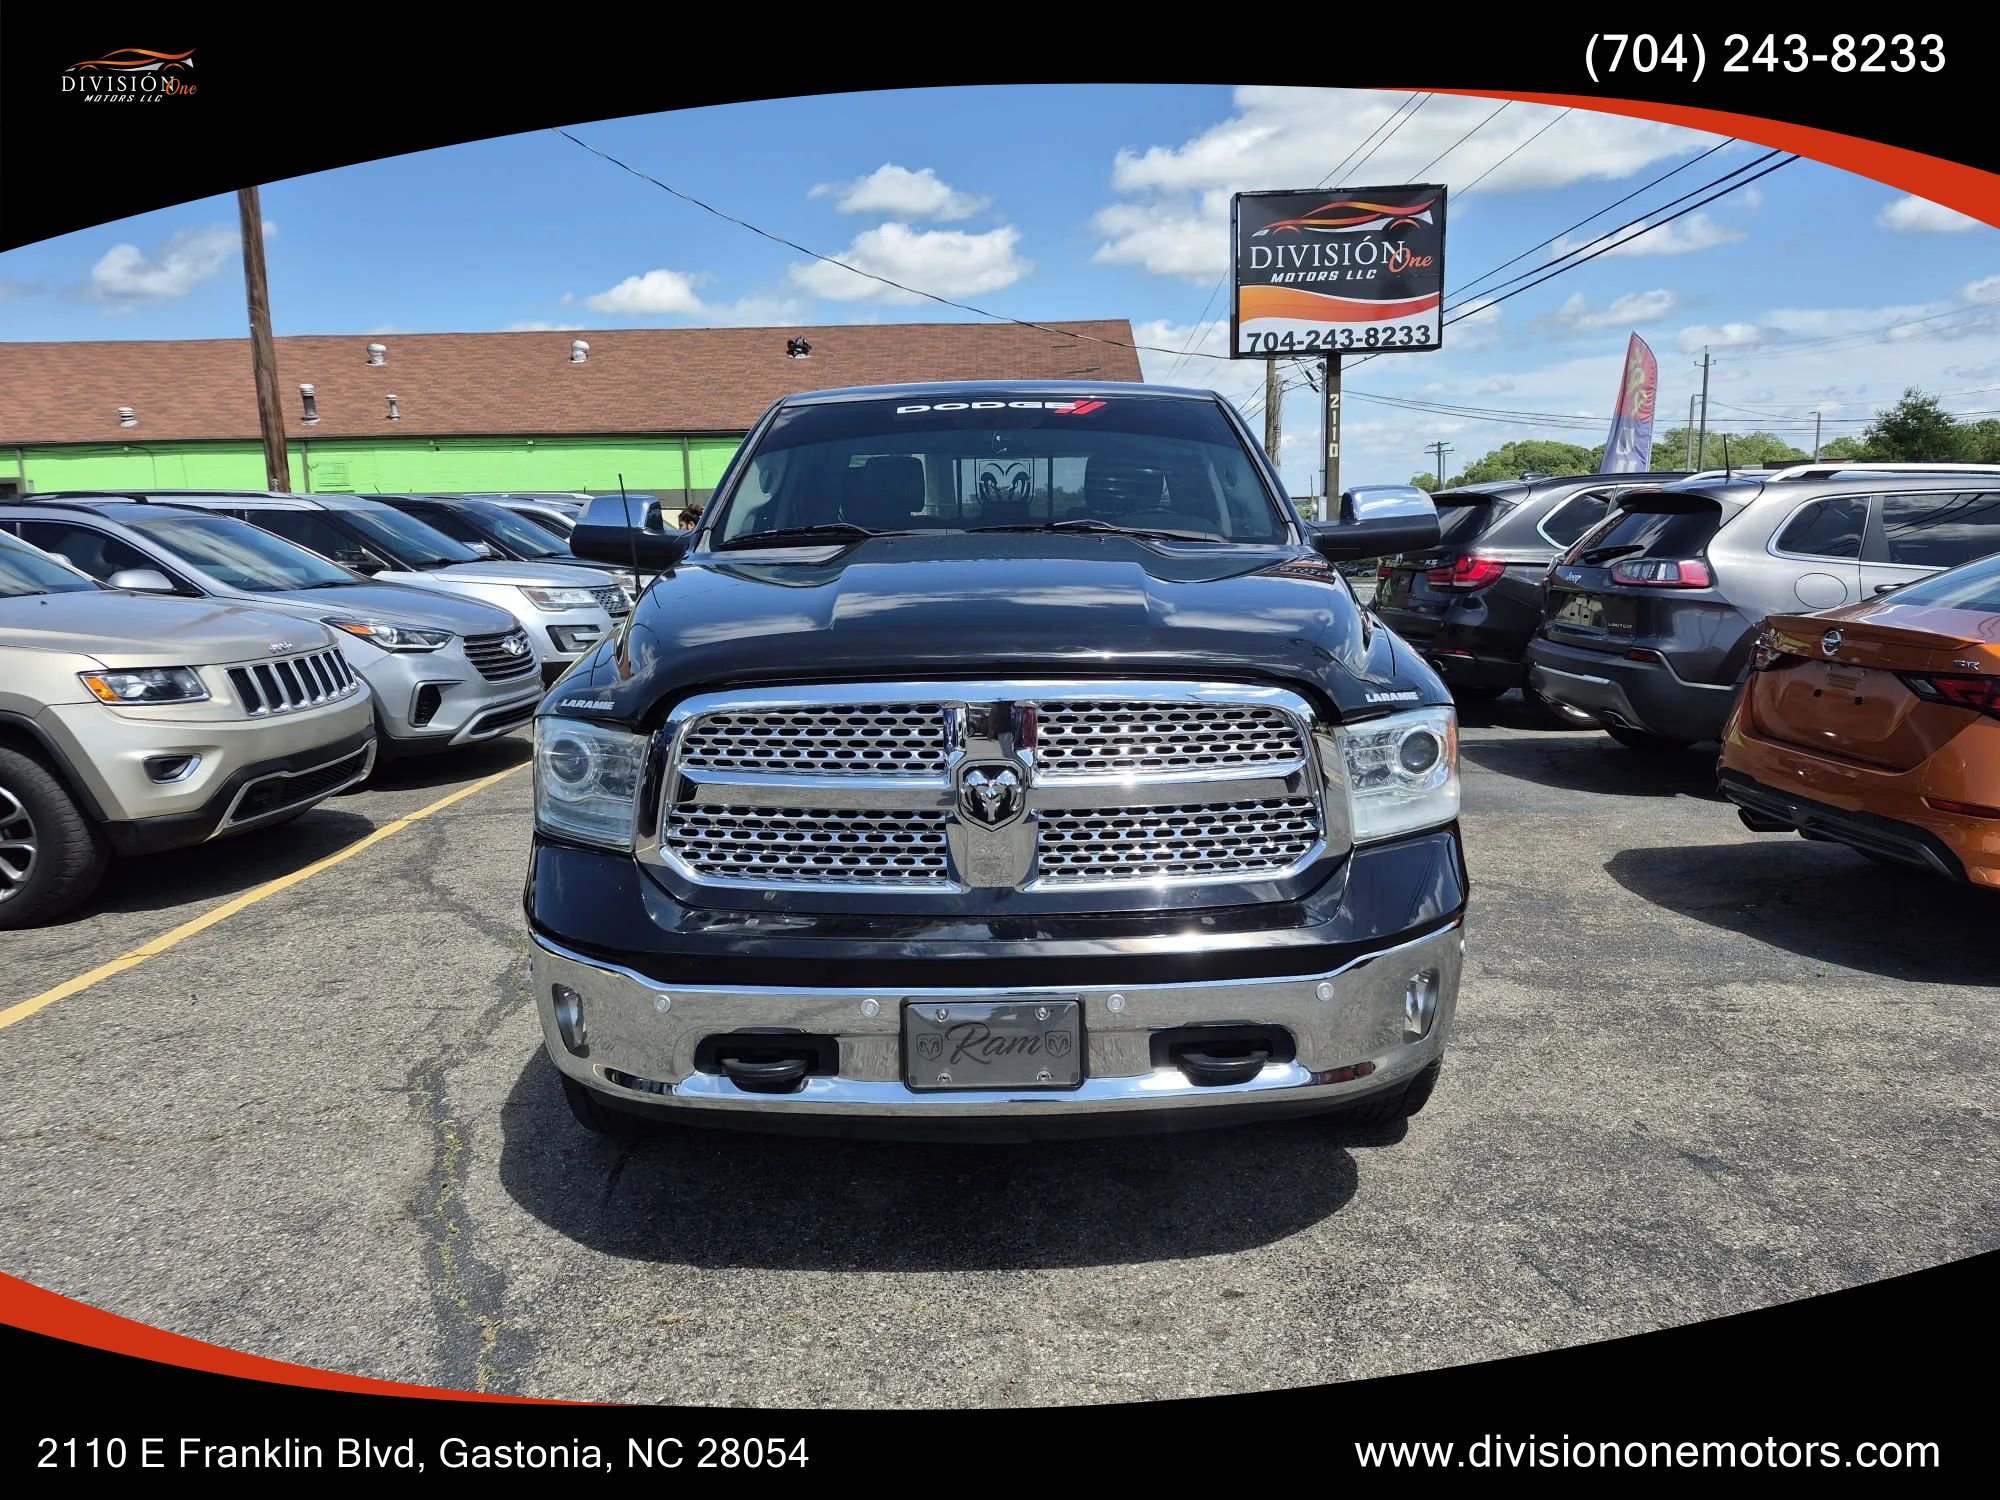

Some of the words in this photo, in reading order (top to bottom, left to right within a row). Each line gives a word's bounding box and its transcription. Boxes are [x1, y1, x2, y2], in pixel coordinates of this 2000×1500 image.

[1250, 236, 1405, 269] DIVISIÓN
[1388, 247, 1433, 274] One
[1271, 269, 1339, 284] MOTORS
[1346, 269, 1378, 280] LLC
[1246, 324, 1431, 352] 704-243-8233
[896, 401, 1077, 414] DODGE
[1329, 393, 1340, 458] 2110
[560, 699, 616, 711] LARAMIE
[1364, 691, 1419, 703] LARAMIE
[944, 1021, 1042, 1065] Ram
